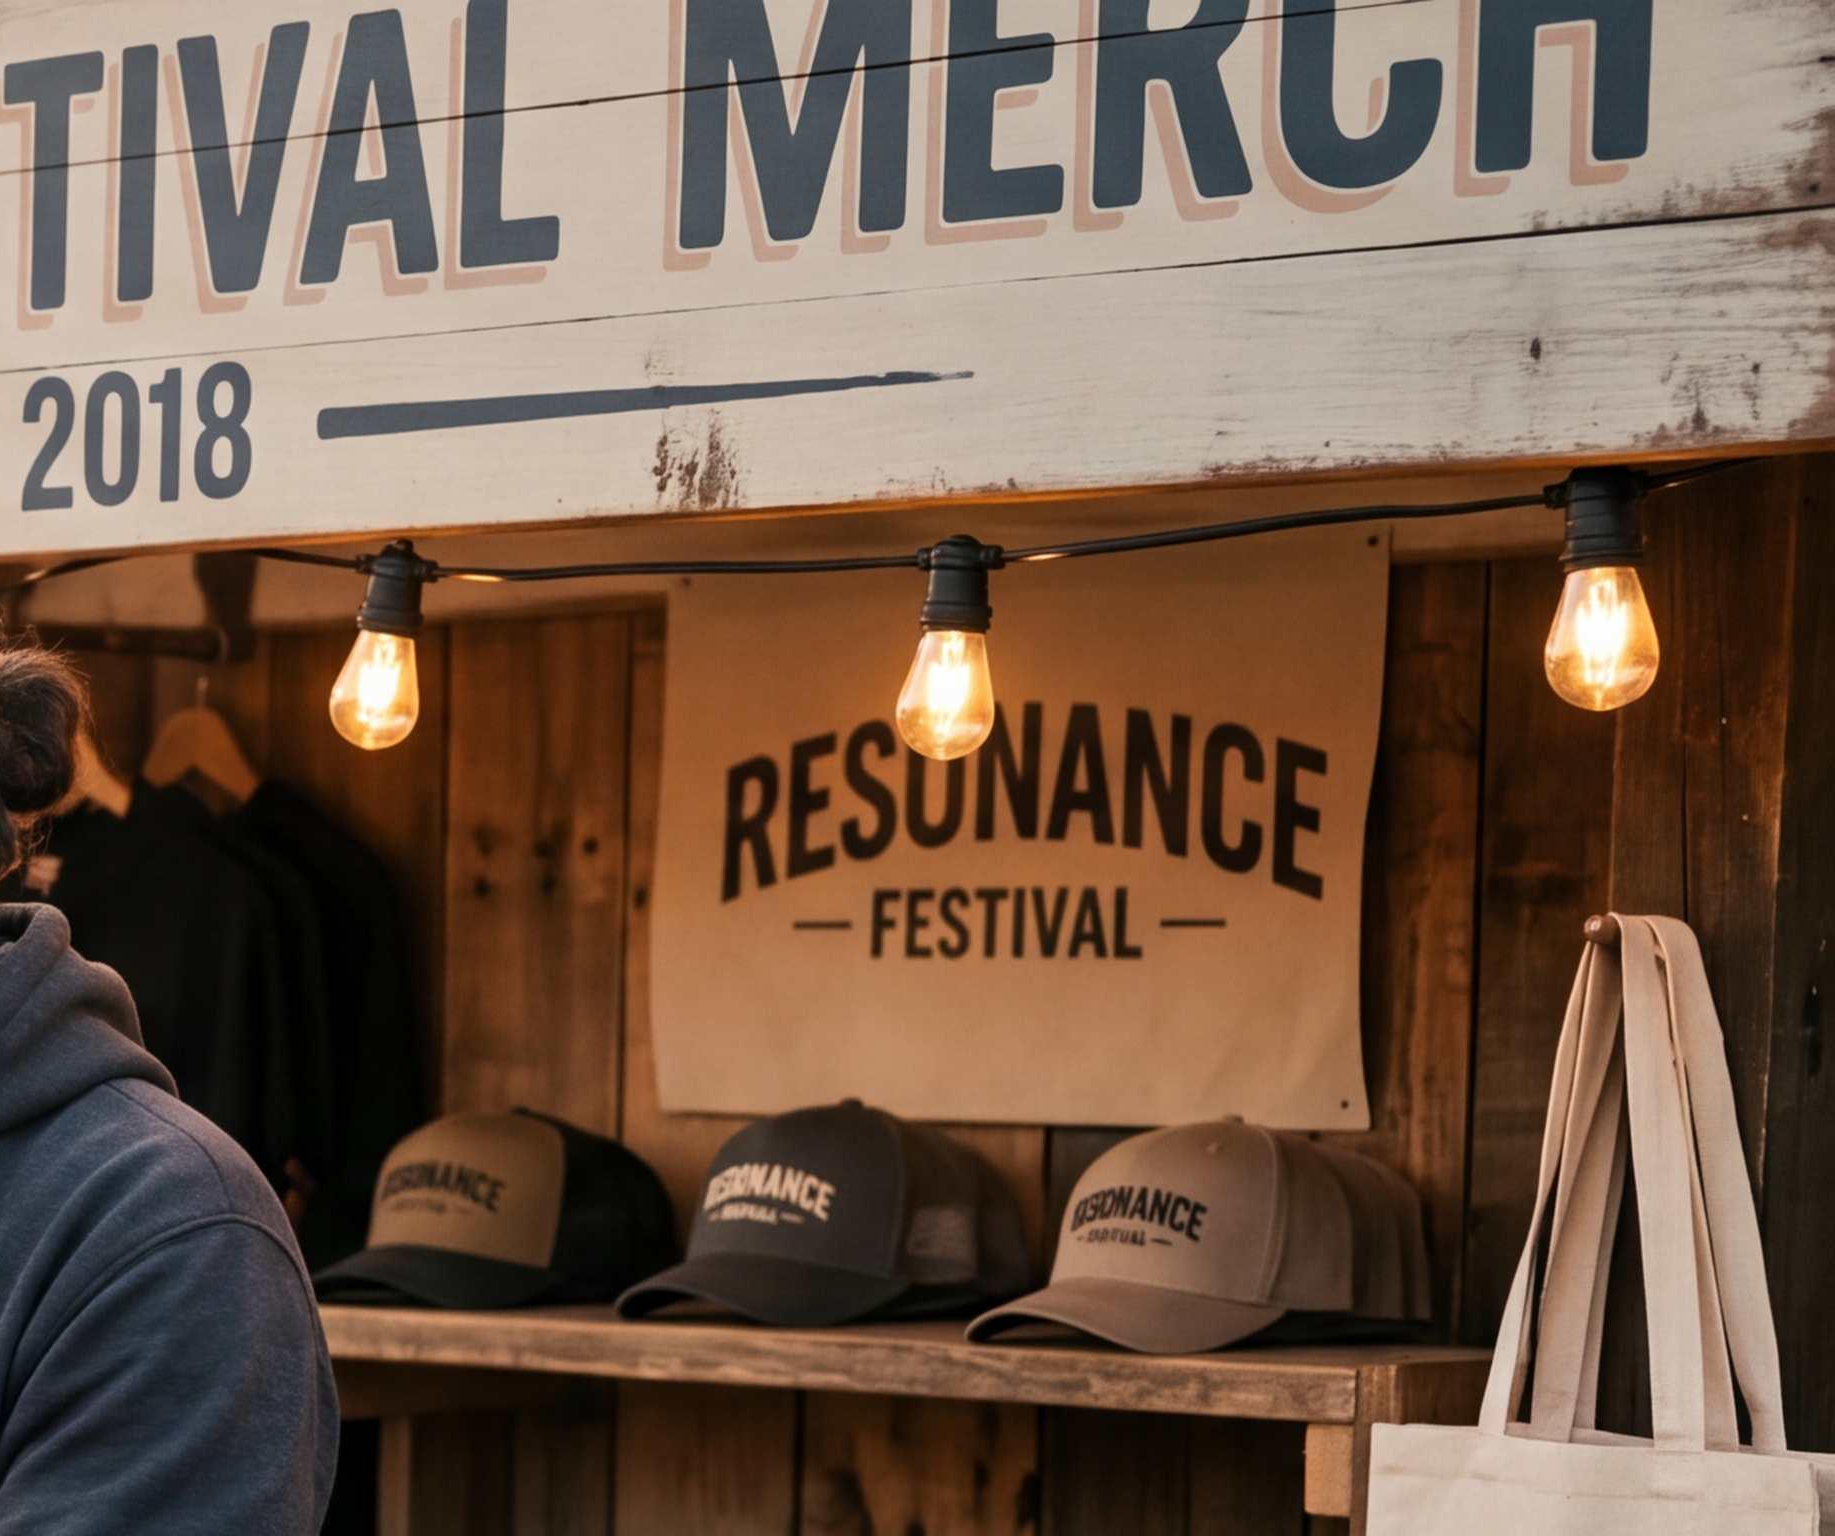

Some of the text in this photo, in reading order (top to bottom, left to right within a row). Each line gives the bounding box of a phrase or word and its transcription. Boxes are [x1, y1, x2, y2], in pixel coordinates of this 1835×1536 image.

[20, 361, 253, 511] 2018
[722, 700, 1327, 904] RESONANCE
[870, 886, 1143, 959] FESTIVAL
